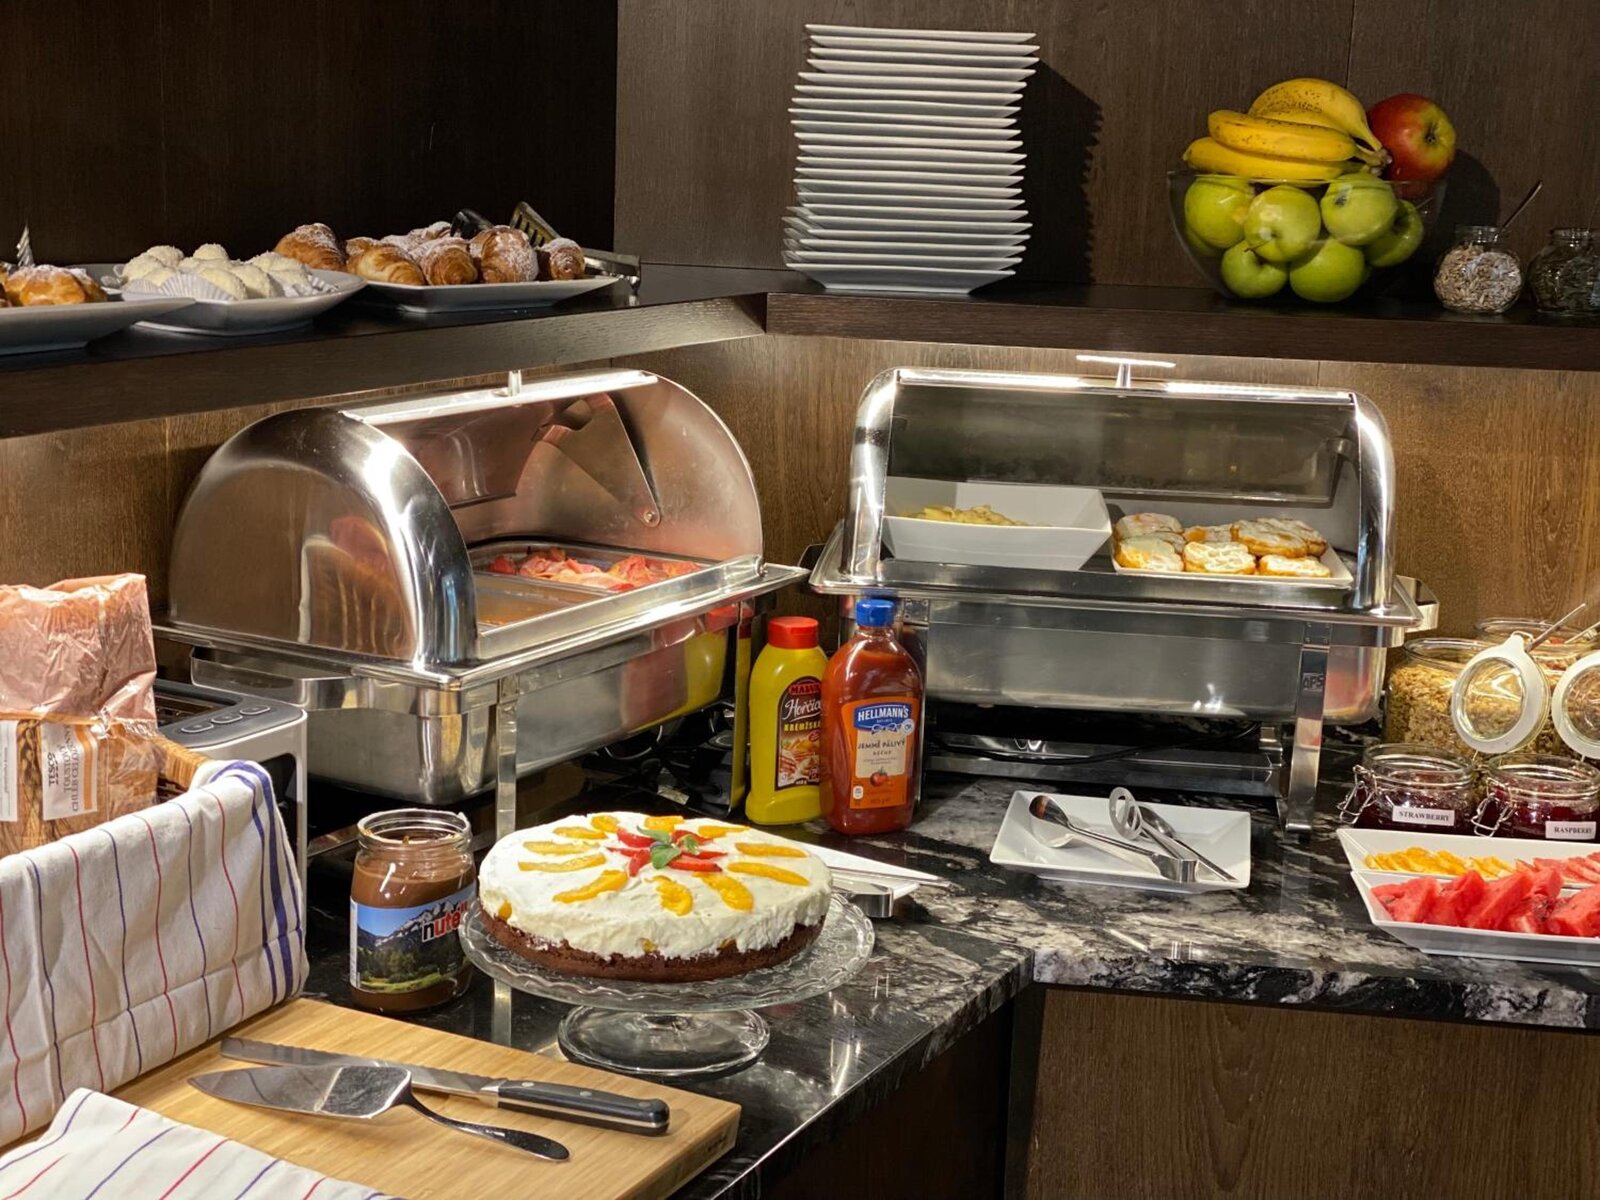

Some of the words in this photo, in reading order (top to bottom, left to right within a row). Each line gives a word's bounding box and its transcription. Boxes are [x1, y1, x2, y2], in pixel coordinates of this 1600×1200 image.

[857, 705, 909, 721] HELLMANN'S
[47, 752, 56, 787] TESCO
[1399, 811, 1449, 822] STRAWBERRY
[1554, 826, 1592, 834] RASPBERRY
